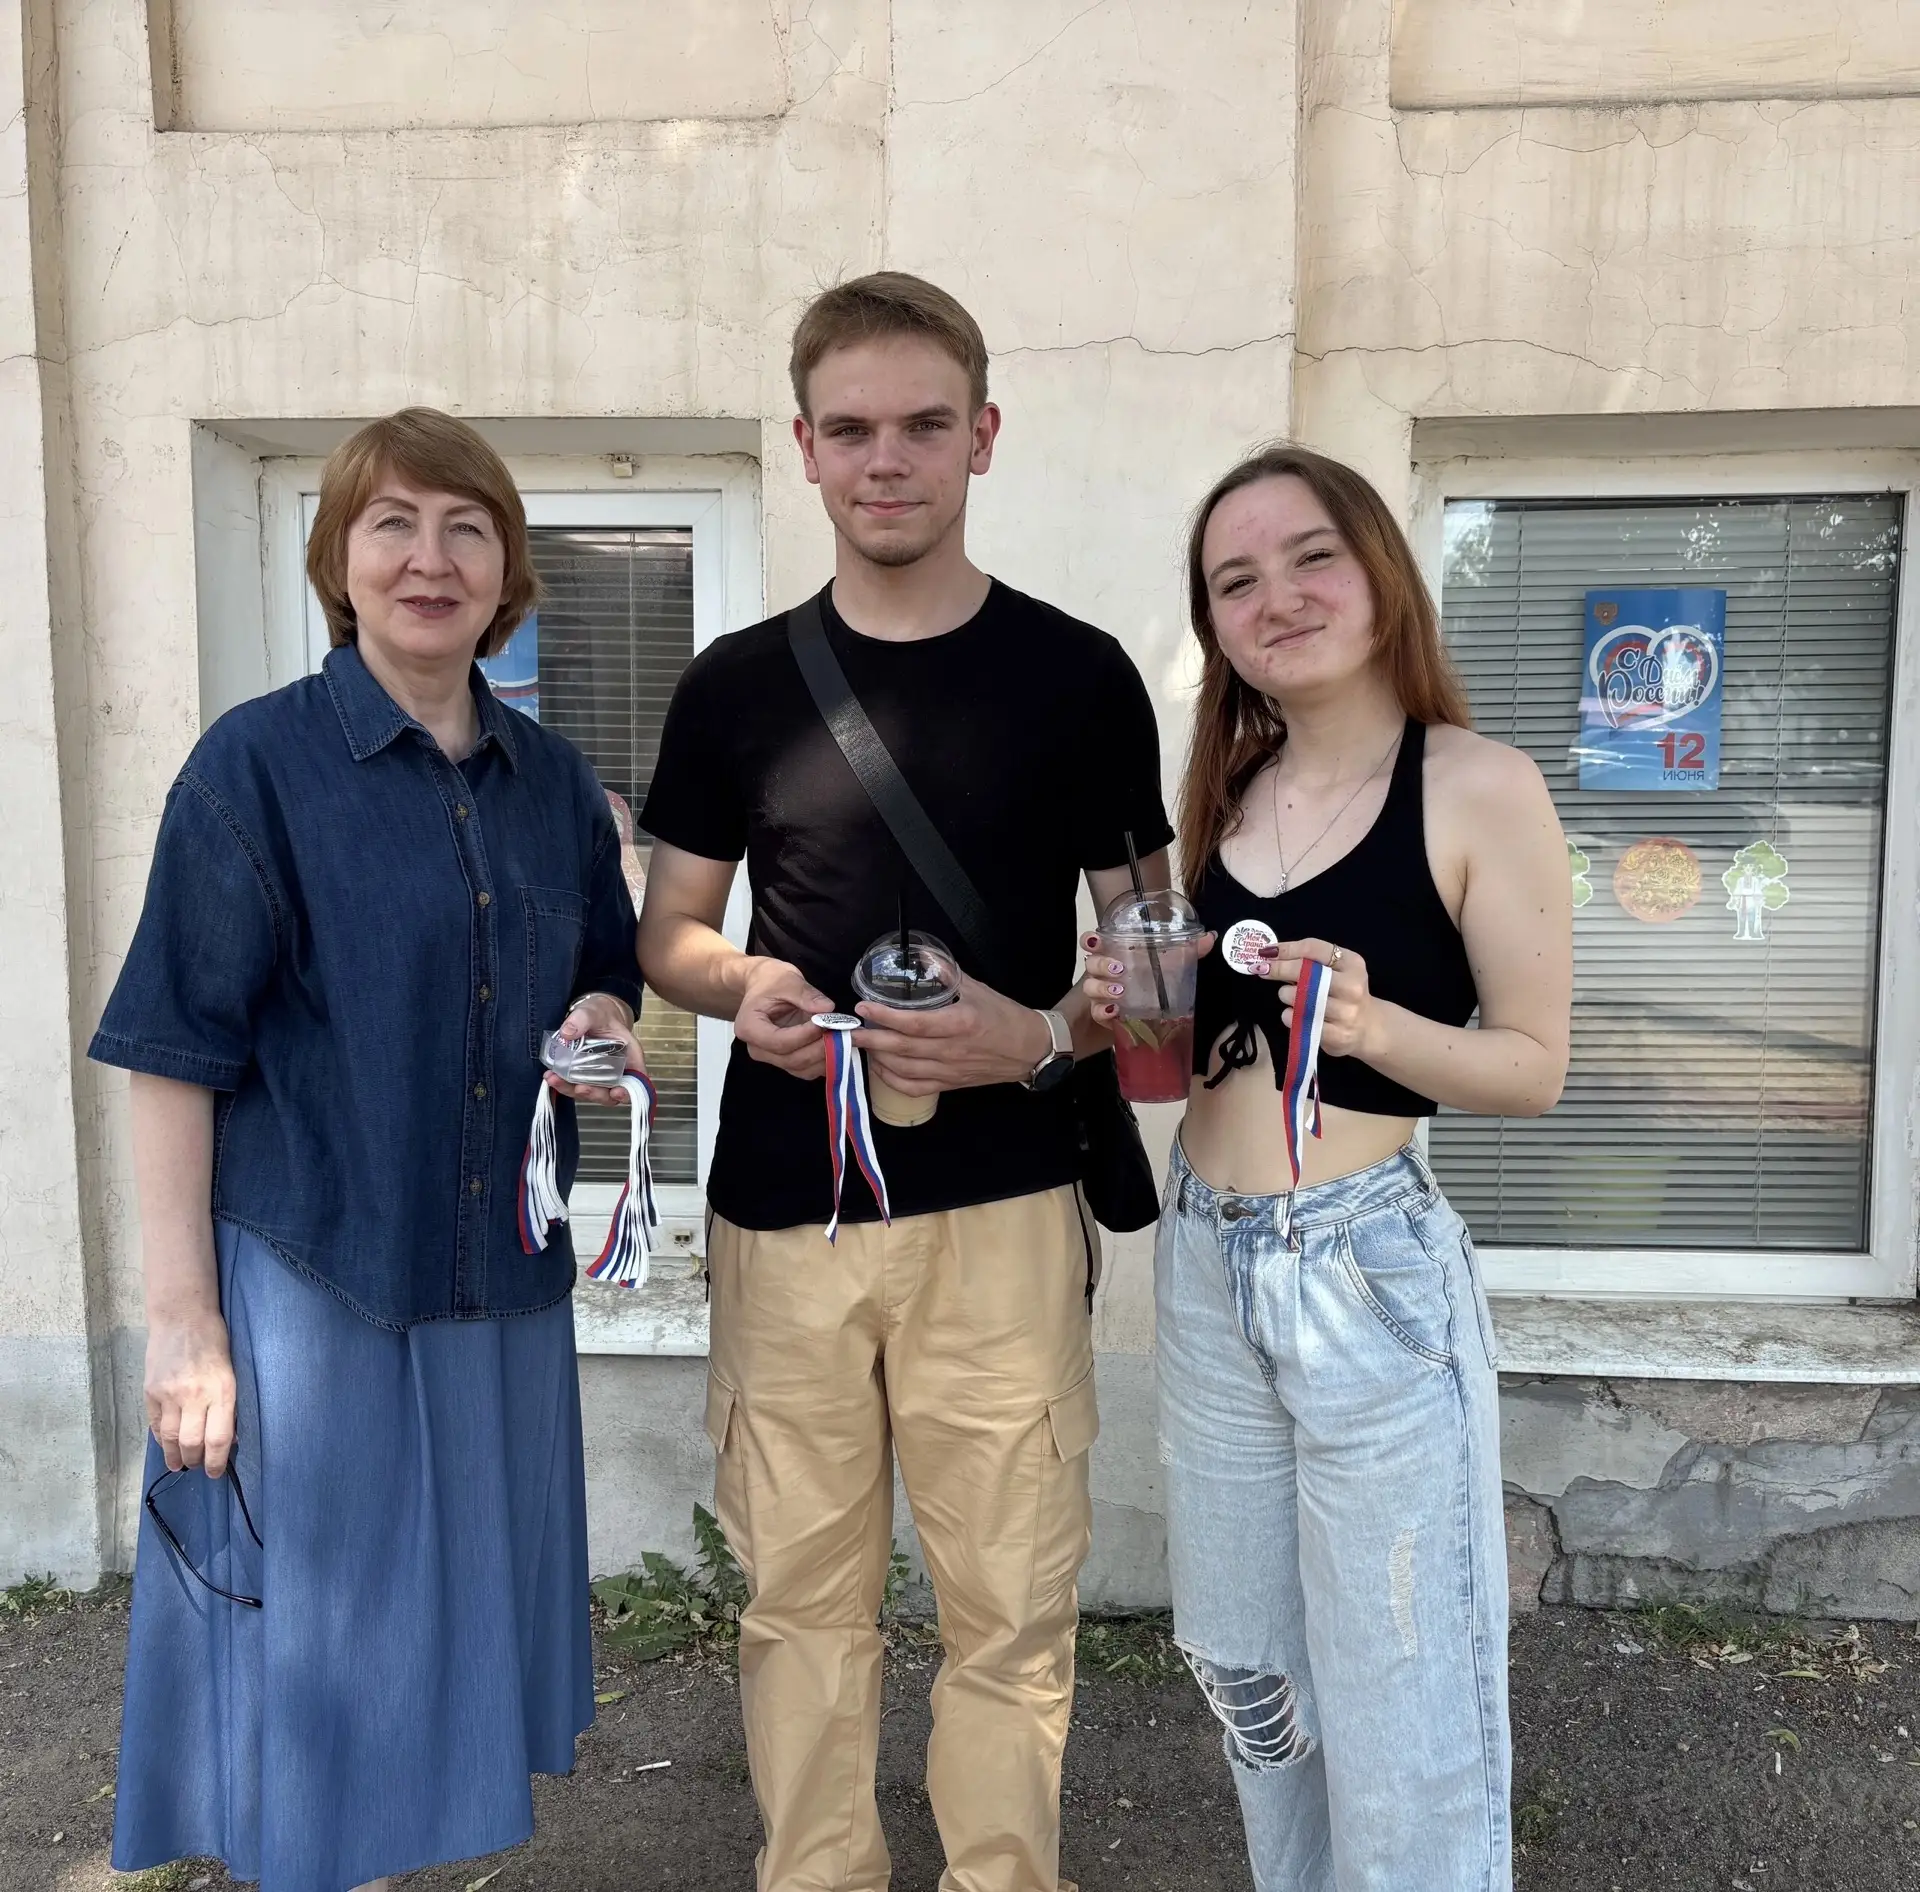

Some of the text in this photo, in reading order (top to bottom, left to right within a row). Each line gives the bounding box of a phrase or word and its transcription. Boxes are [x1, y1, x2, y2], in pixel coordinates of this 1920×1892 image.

[1616, 648, 1640, 670] С
[1598, 670, 1705, 728] России!
[1657, 733, 1705, 768] 12
